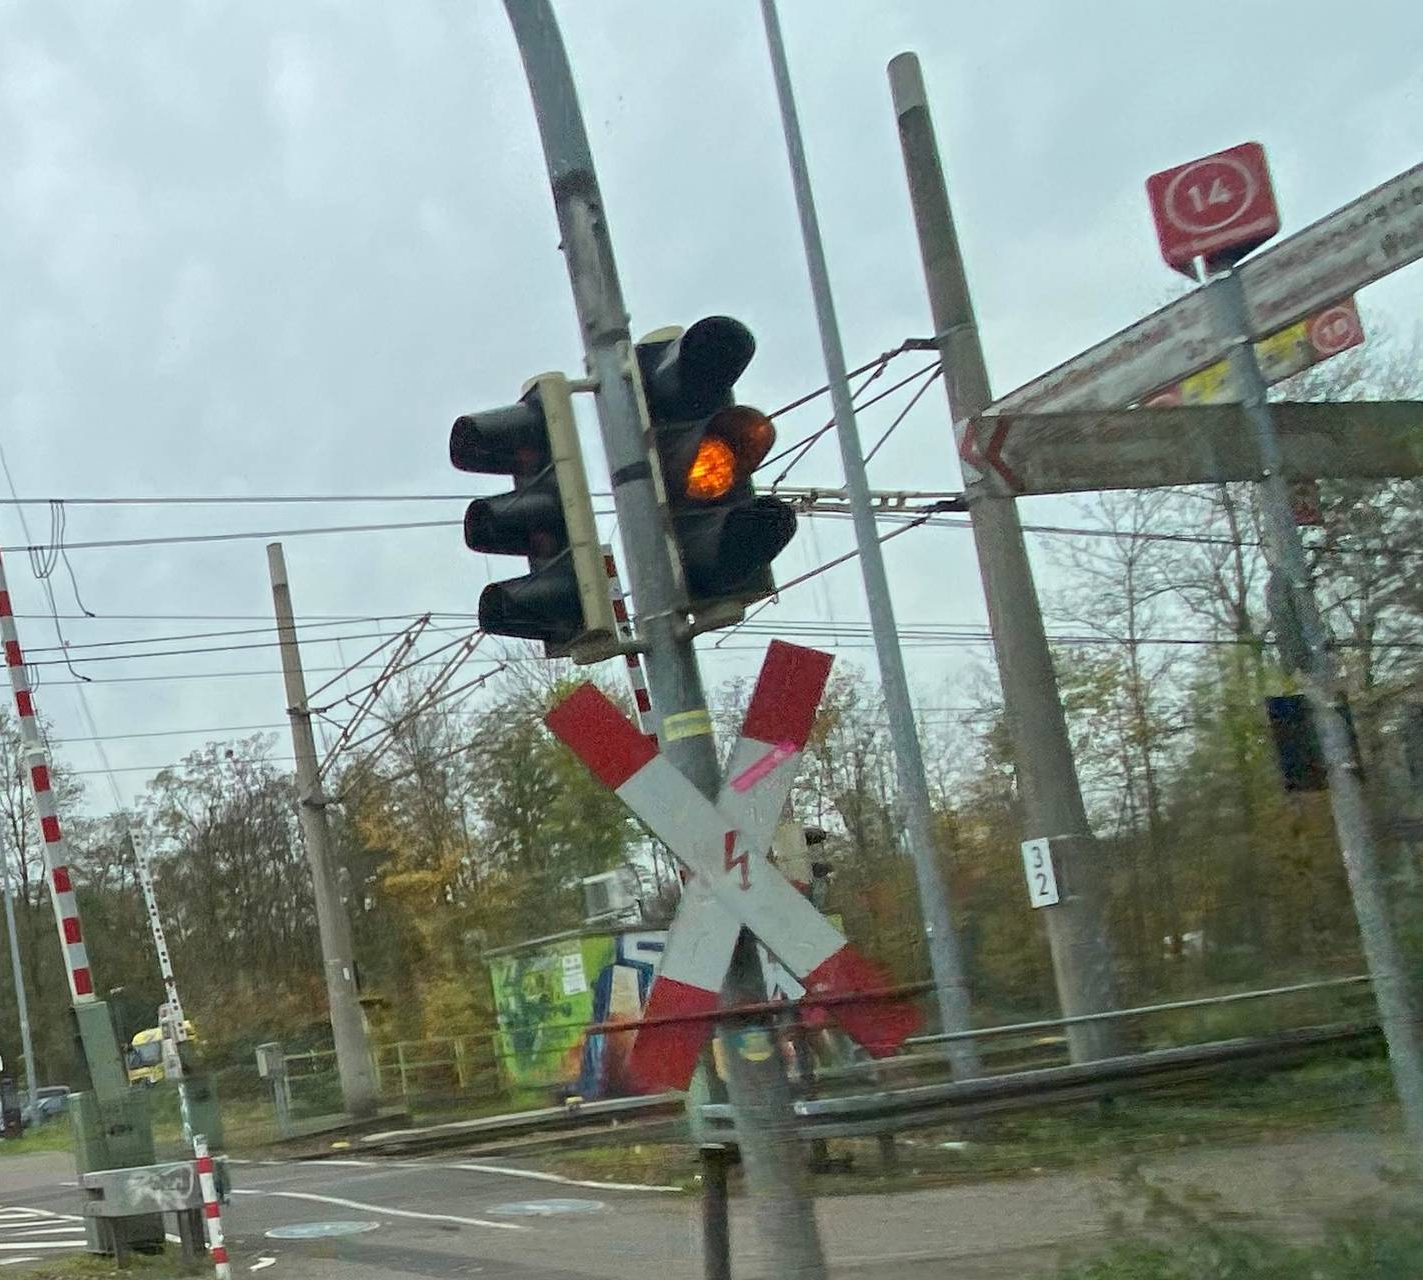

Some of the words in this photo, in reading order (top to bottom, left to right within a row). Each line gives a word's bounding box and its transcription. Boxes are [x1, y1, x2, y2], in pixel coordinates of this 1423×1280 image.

[1187, 178, 1233, 213] 14
[1032, 846, 1043, 868] 3
[1035, 873, 1049, 896] 2
